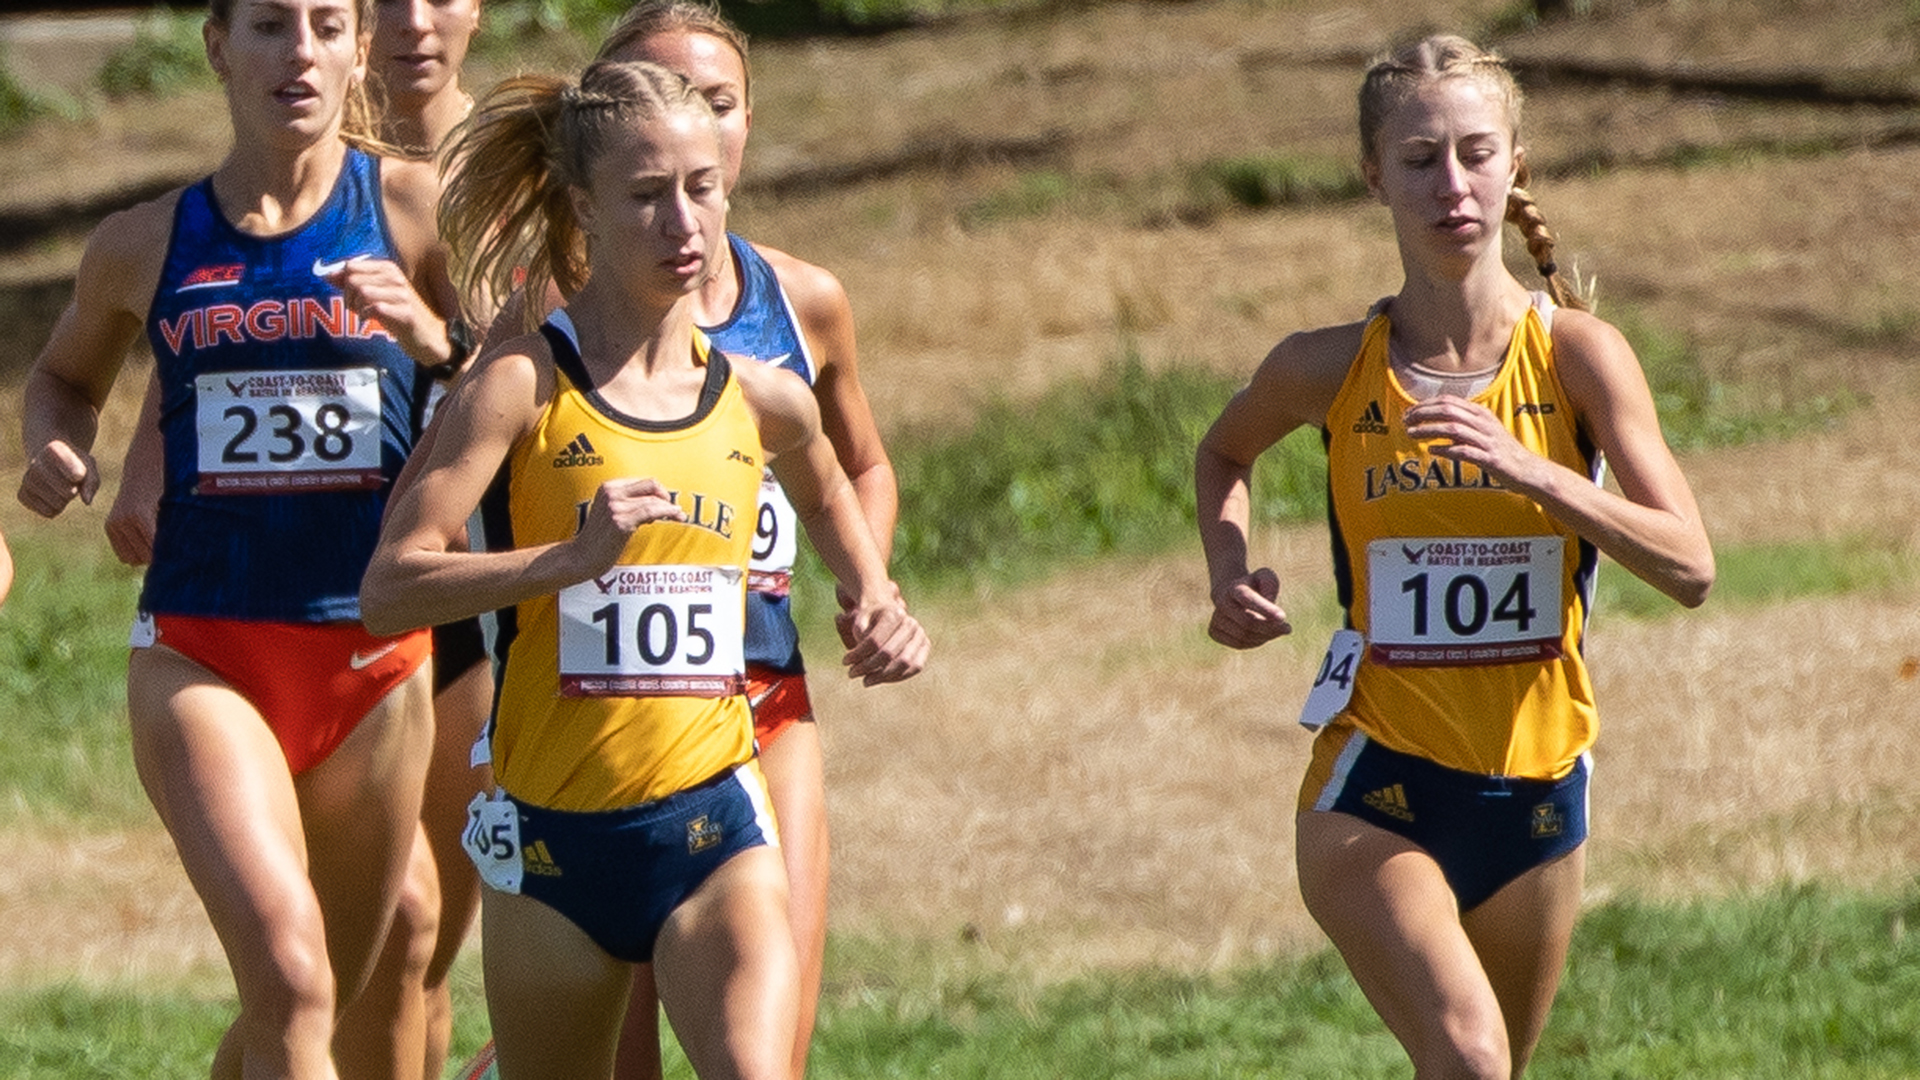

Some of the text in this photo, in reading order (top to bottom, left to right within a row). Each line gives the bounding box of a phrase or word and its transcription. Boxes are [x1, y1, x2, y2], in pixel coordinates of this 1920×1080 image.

[221, 403, 353, 464] 238
[1352, 422, 1389, 435] adidas
[553, 453, 604, 469] adidas
[1426, 542, 1531, 556] COAST-TO-COAST
[618, 571, 713, 585] COAST-TO-COAST
[618, 585, 650, 595] BATTLE
[1402, 572, 1537, 637] 104
[592, 602, 715, 667] 105
